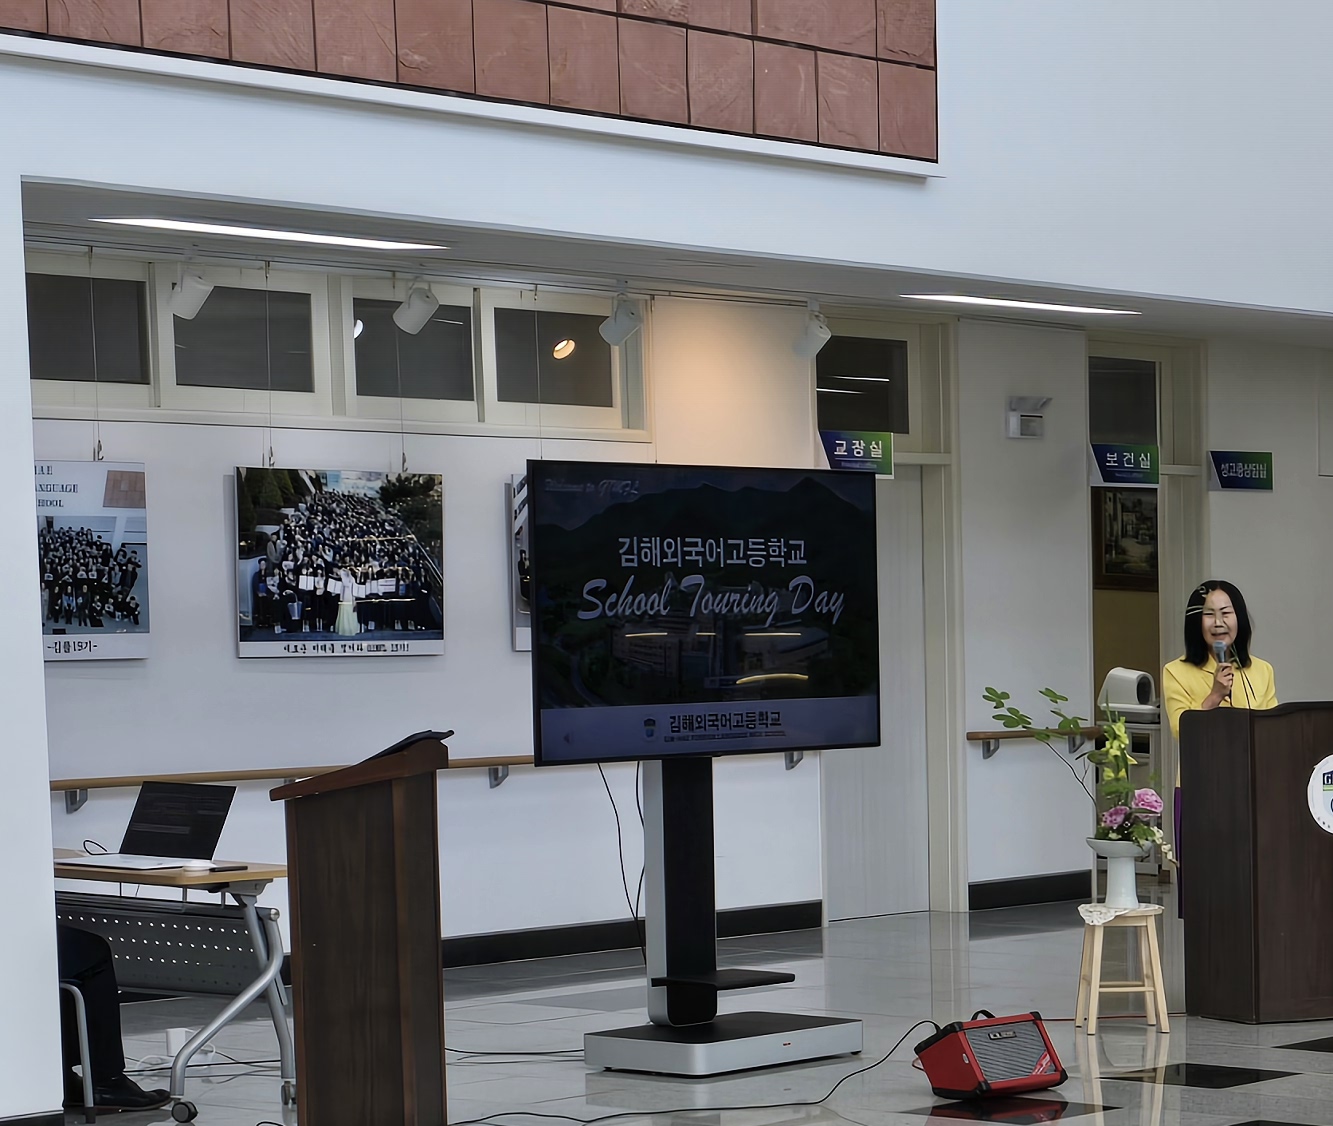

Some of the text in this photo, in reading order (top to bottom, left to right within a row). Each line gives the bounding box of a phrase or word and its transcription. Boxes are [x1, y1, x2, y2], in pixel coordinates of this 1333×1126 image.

[834, 440, 883, 458] 교장실
[1105, 452, 1151, 469] 보건실
[618, 536, 807, 568] 김해외국어고등학교
[577, 574, 844, 625] School Touring Day
[669, 711, 782, 734] 김해외국어고등학교
